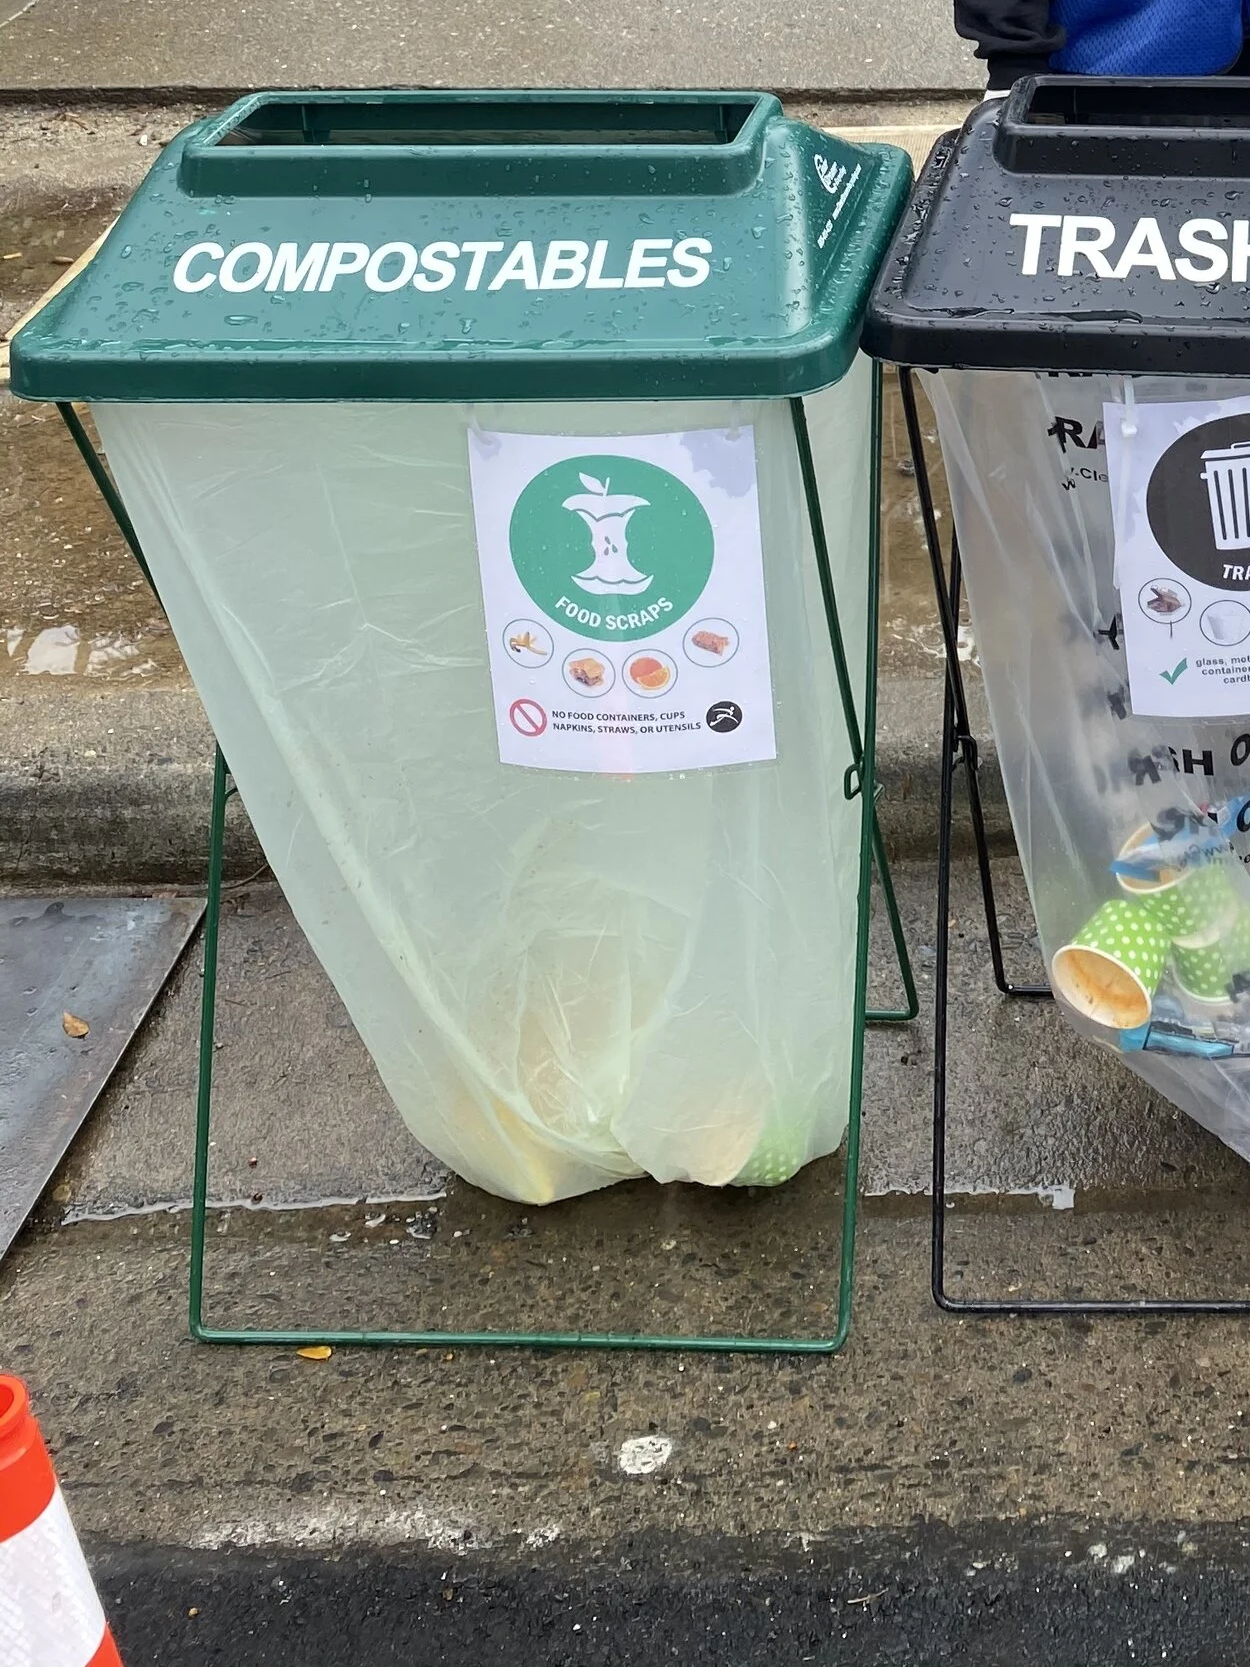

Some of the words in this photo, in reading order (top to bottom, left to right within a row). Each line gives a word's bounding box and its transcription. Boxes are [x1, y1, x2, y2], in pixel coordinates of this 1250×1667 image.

[173, 238, 713, 293] COMPOSTABLES
[554, 595, 601, 628] FOOD
[605, 597, 674, 630] SCRAPS
[1196, 656, 1227, 668] glass,
[552, 711, 566, 719] NO
[567, 712, 594, 721] FOOD
[596, 713, 658, 722] CONTAINERS,
[660, 711, 685, 720] CUPS
[553, 722, 595, 734] NAPKINS,
[597, 724, 638, 734] STRAWS,
[655, 722, 701, 732] UTENSILS
